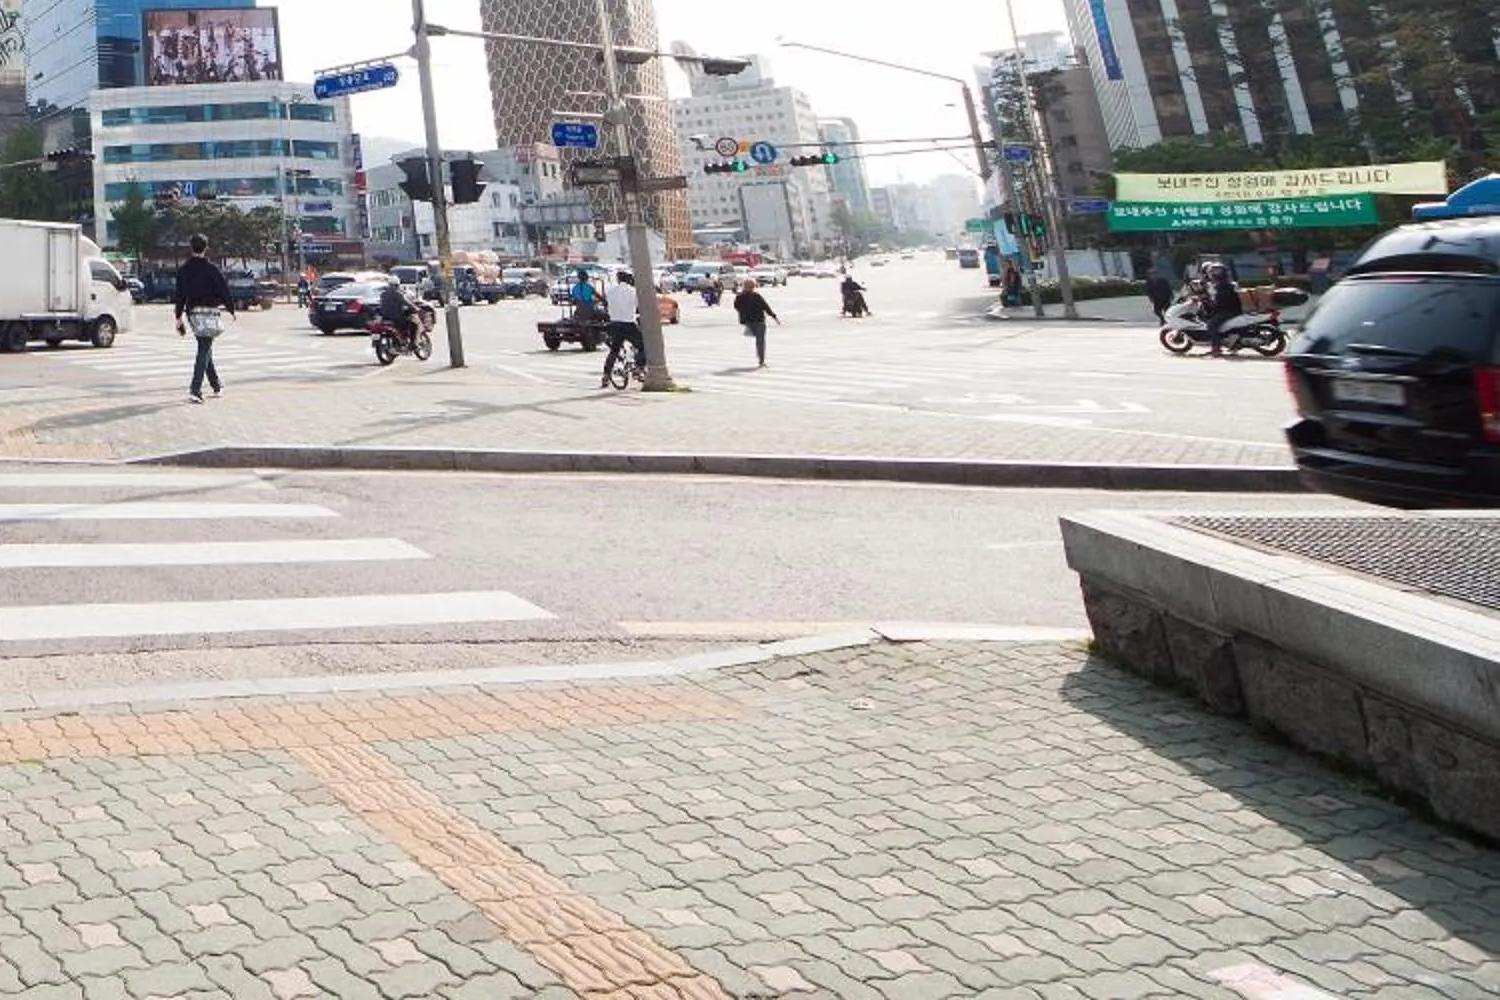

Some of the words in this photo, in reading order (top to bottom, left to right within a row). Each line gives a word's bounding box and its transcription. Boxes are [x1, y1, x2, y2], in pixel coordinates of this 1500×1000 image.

[1157, 176, 1220, 190] 보내주신
[1284, 169, 1390, 187] 감사드립니다
[1114, 205, 1167, 217] 보내주신
[1268, 198, 1363, 214] 감사드립니다
